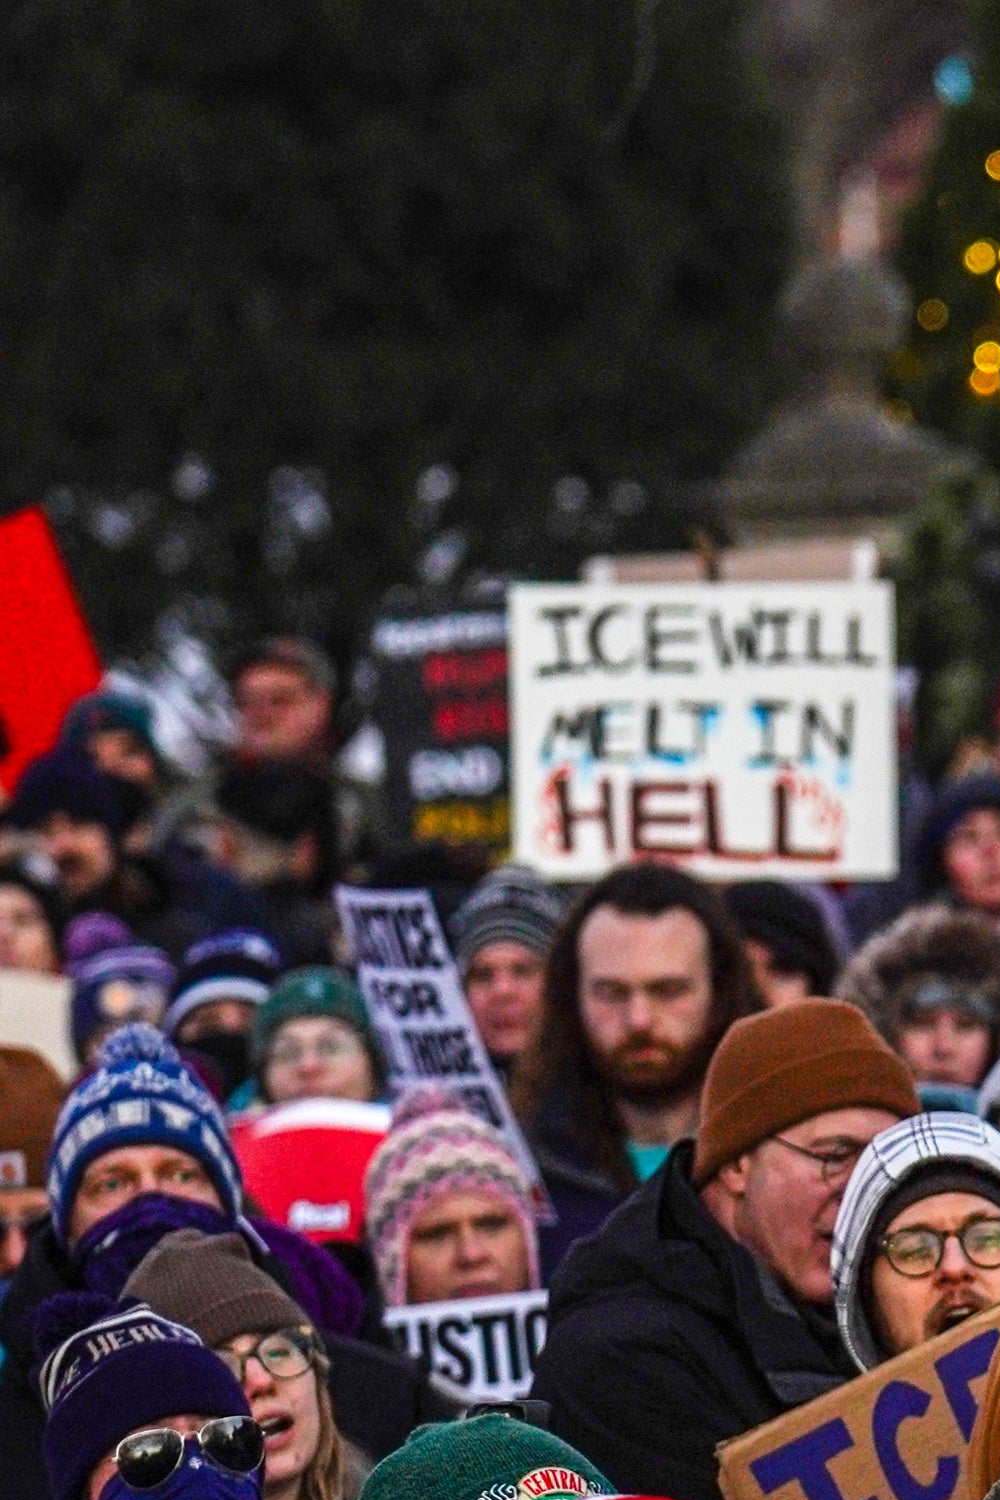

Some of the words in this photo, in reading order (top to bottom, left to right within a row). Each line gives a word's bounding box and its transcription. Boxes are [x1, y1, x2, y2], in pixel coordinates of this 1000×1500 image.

[537, 604, 699, 676] ICE
[709, 608, 879, 672] WILL
[541, 699, 721, 768] MELT
[749, 699, 856, 768] IN
[546, 773, 842, 863] HELL
[522, 1468, 586, 1497] CENTRAL
